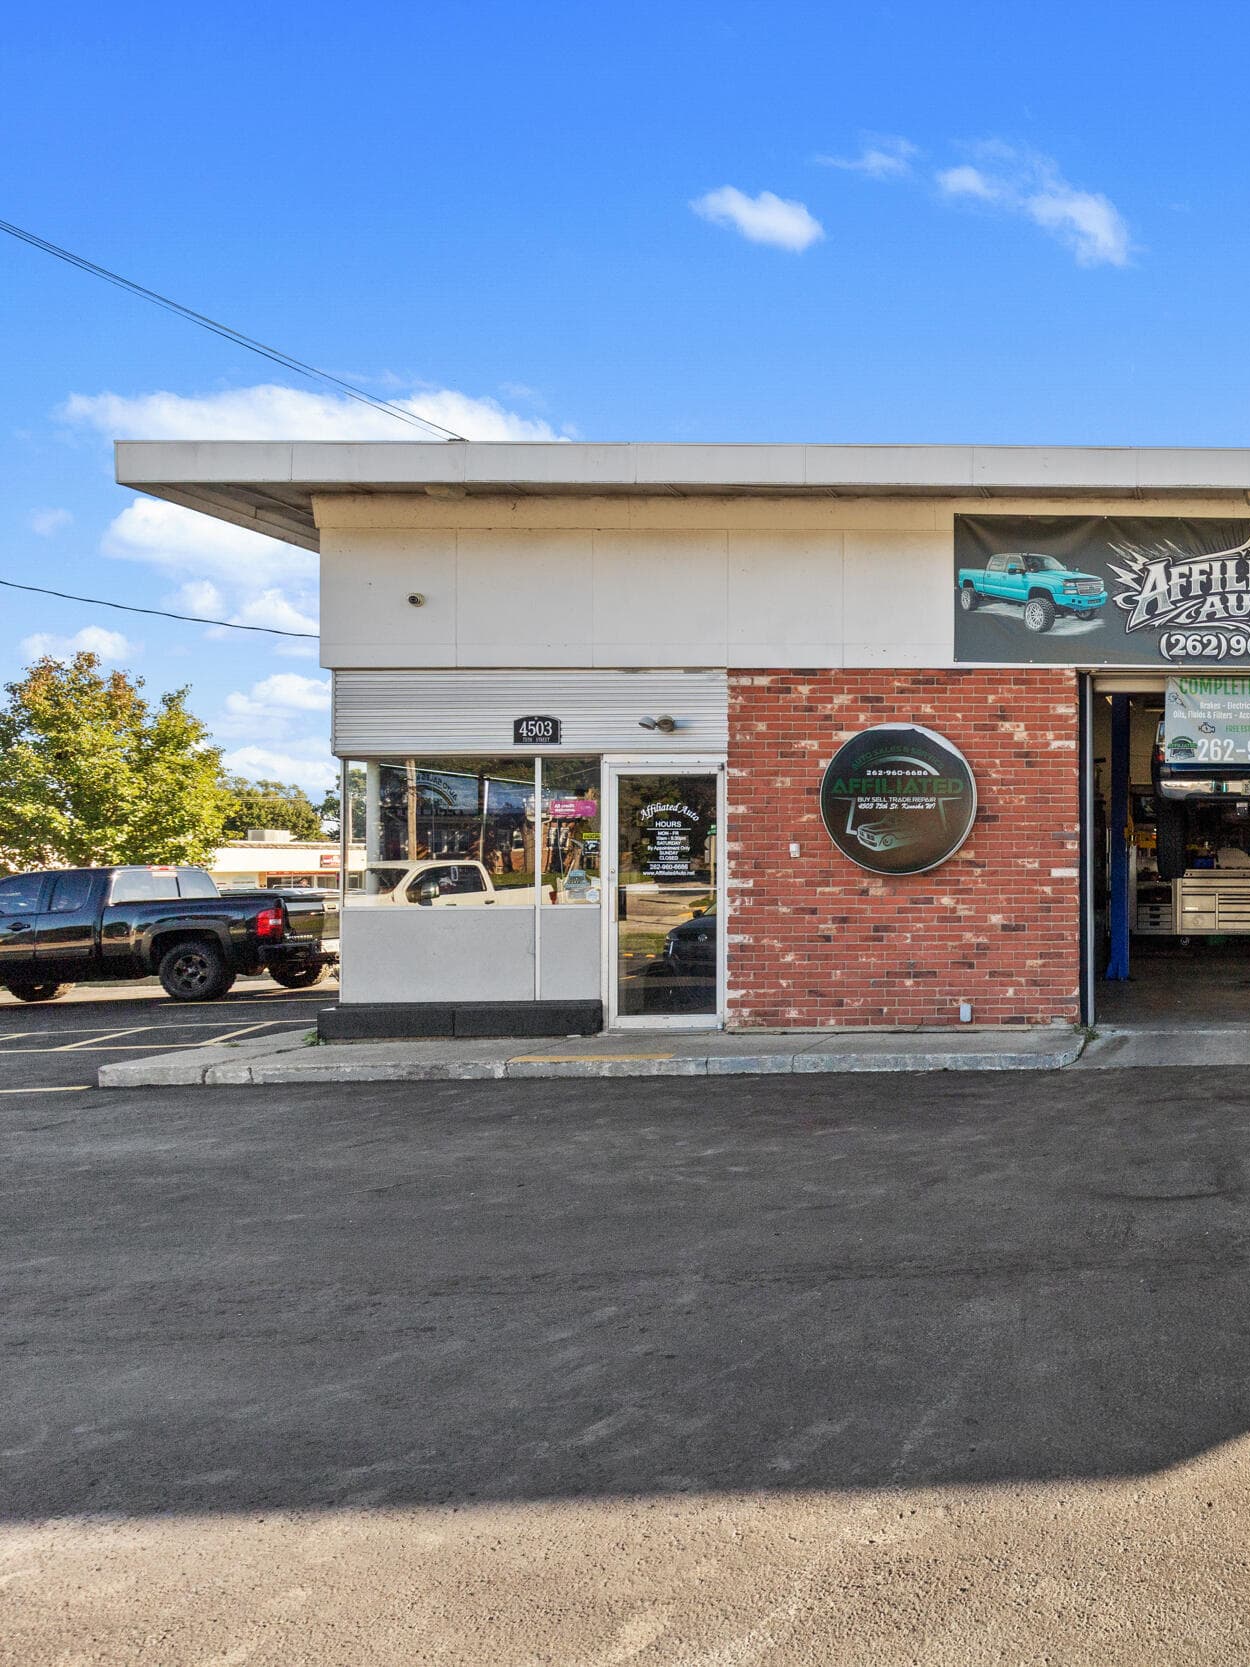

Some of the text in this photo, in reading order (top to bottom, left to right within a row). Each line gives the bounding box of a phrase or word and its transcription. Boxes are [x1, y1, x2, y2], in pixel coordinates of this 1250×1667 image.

[1199, 702, 1220, 710] Brakes
[1188, 711, 1206, 719] Fluids
[1213, 711, 1233, 719] Filters
[519, 720, 553, 737] 4503
[1226, 724, 1240, 733] FREE
[831, 778, 964, 794] AFFILIATED
[640, 802, 700, 822] Affiliated Auto
